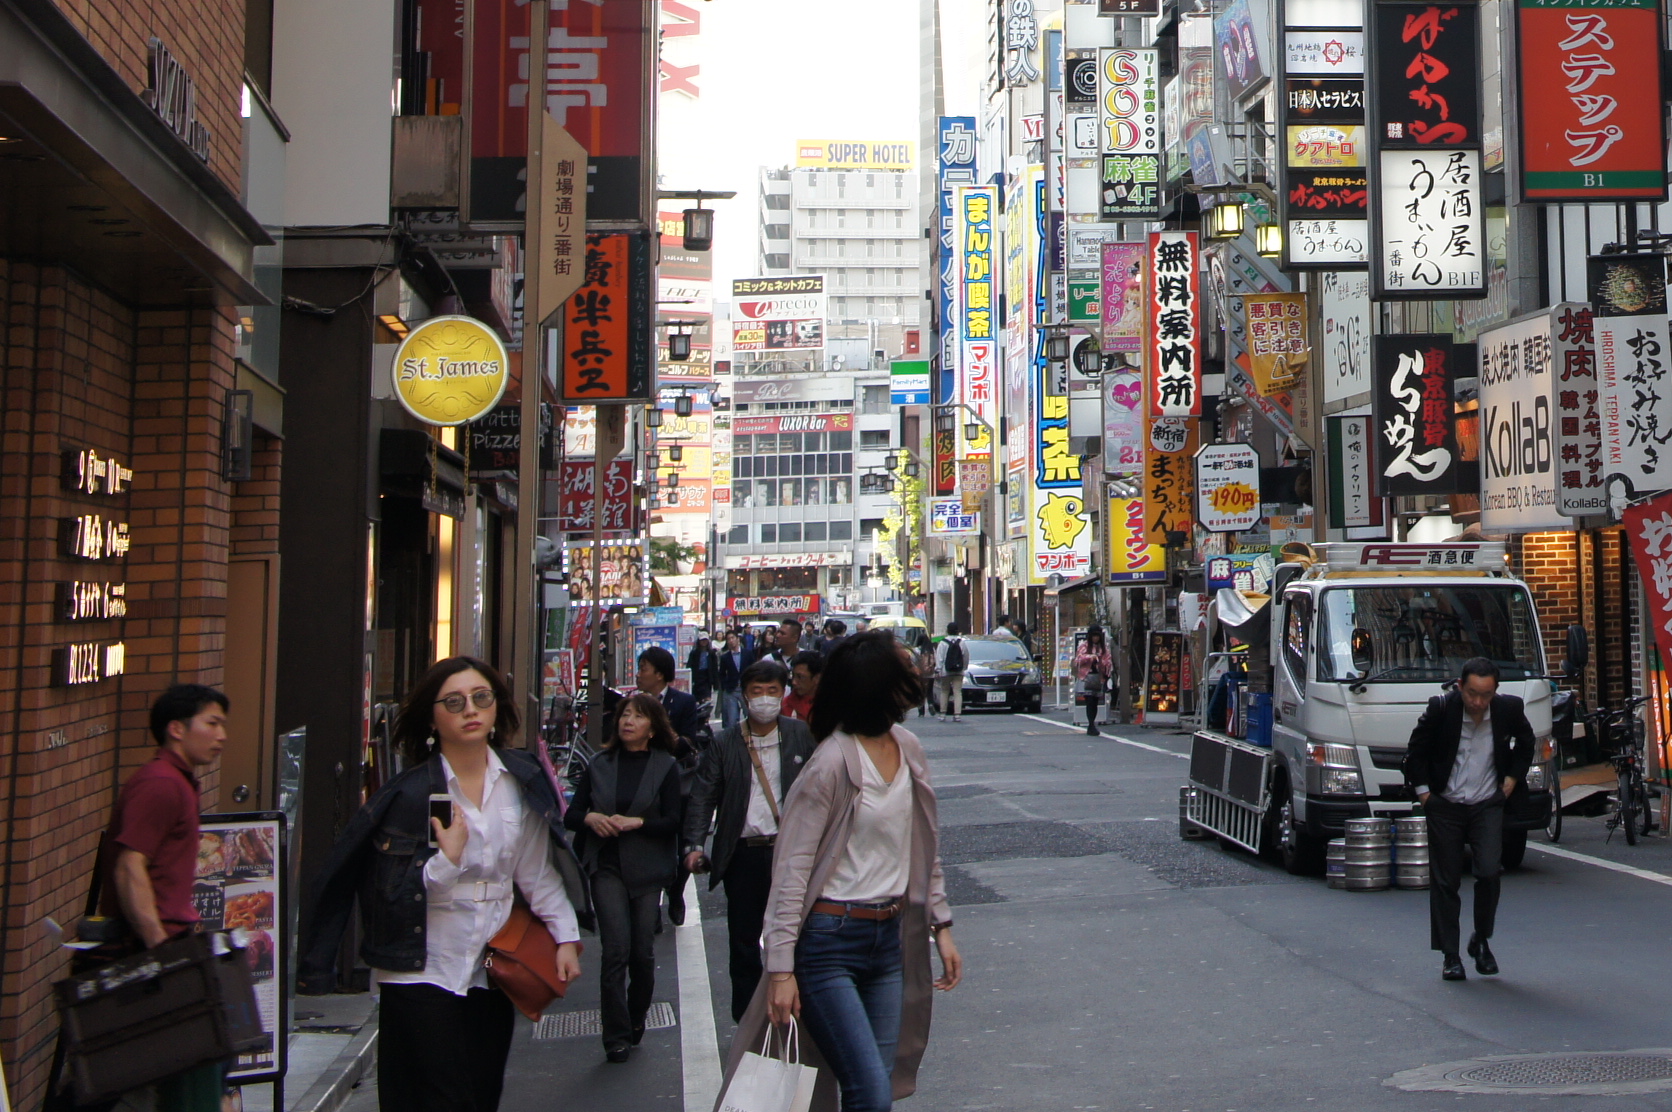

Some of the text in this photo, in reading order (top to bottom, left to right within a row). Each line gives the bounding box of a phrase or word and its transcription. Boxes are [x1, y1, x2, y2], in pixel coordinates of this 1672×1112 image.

[1104, 50, 1141, 152] GOD
[1558, 13, 1623, 167] ステップ
[828, 143, 867, 163] SUPER
[873, 144, 910, 164] HOTEL
[1294, 140, 1354, 157] クアトロ
[1103, 156, 1158, 183] 麻雀
[1583, 173, 1605, 187] B1
[1128, 184, 1157, 205] 4F
[1439, 151, 1472, 261] 居酒屋
[553, 159, 575, 276] 劇場通り一番街
[1291, 221, 1339, 235] 居酒屋
[966, 196, 991, 338] まんが喫茶
[1388, 241, 1404, 287] 一番街
[1447, 271, 1480, 287] B1F
[1250, 302, 1301, 320] 悪質な
[1156, 240, 1192, 408] 無料案内所
[1251, 320, 1302, 337] 客引き
[1253, 338, 1304, 356] に注意
[1558, 308, 1596, 381] 焼肉
[1601, 330, 1616, 388] HIROSHIMA
[1422, 347, 1448, 447] 東京豚骨
[1623, 328, 1672, 474] お好み焼き
[778, 416, 808, 432] LUXOR
[1152, 425, 1185, 443] 新宿
[1560, 390, 1582, 489] 韓国料理
[1484, 488, 1506, 511] Korean
[1563, 497, 1607, 509] KollaBo
[1037, 553, 1089, 570] マンボー
[1427, 550, 1475, 565] 酒急便
